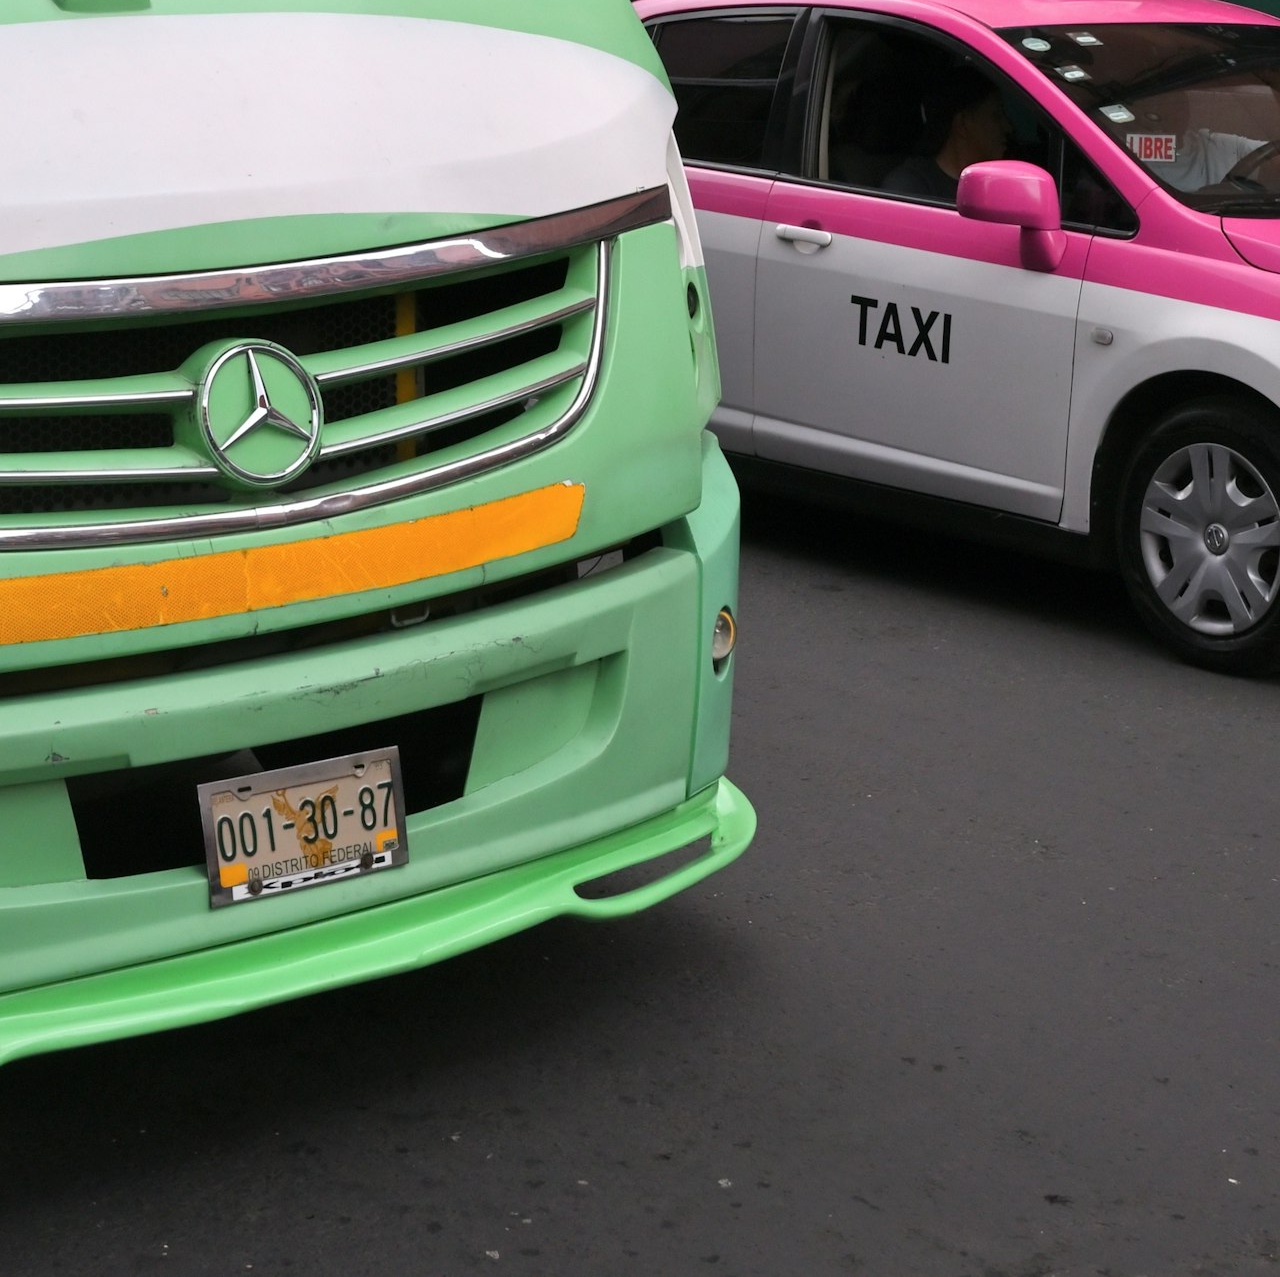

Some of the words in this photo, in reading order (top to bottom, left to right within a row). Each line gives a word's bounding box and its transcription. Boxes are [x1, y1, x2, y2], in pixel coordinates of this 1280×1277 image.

[1130, 137, 1173, 160] LIBRE
[851, 294, 953, 364] TAXI
[216, 780, 394, 863] 001-30-87
[262, 853, 319, 878] DISTRITO
